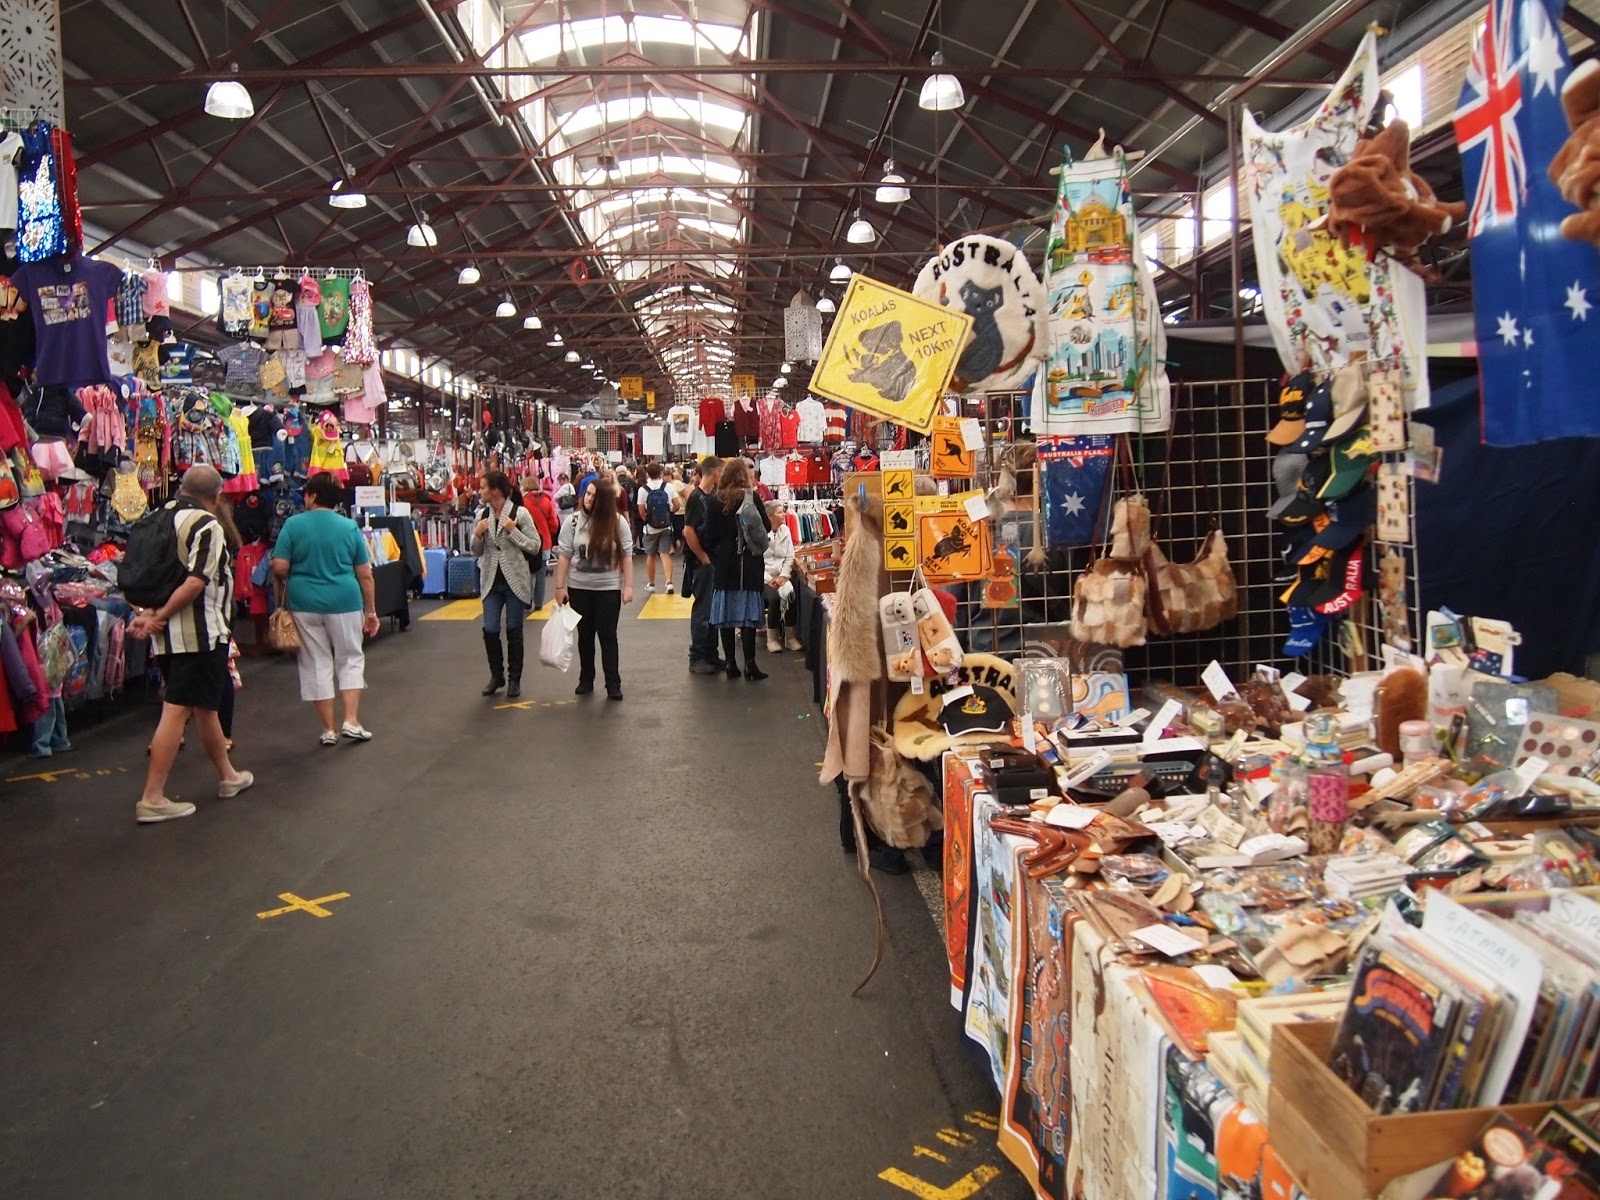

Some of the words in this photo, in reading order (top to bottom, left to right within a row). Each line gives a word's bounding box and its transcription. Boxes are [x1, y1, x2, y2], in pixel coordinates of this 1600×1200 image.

[932, 240, 1036, 318] AUSTRALIA
[850, 299, 897, 325] KOALAS
[908, 320, 947, 345] NEXT
[956, 518, 979, 541] KOALA
[924, 556, 942, 572] NEXT
